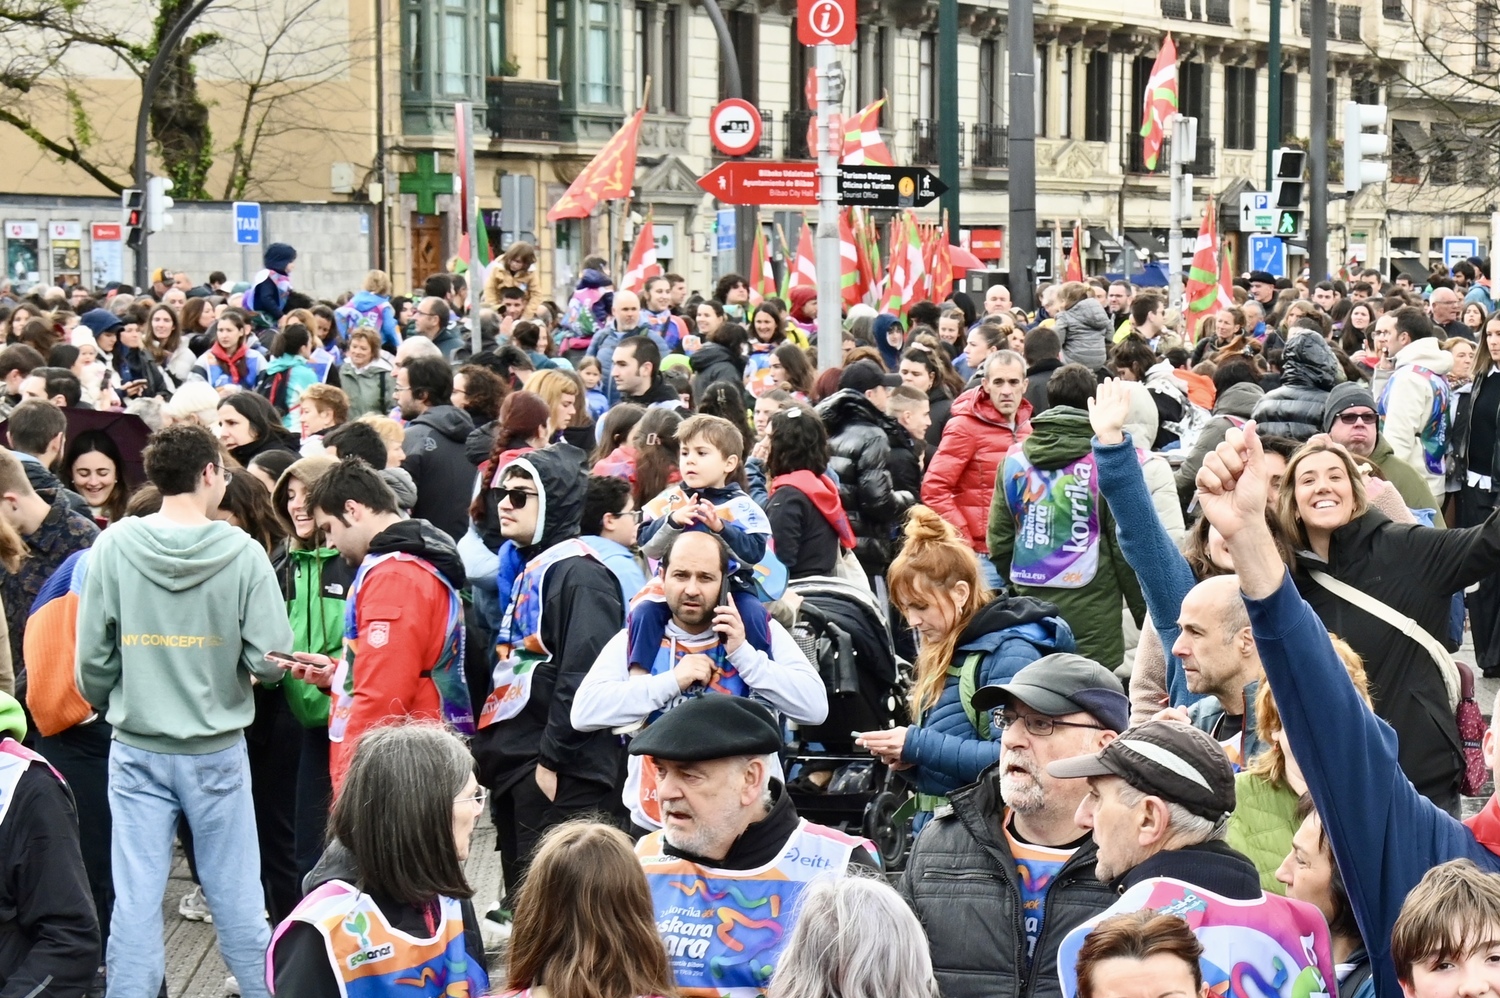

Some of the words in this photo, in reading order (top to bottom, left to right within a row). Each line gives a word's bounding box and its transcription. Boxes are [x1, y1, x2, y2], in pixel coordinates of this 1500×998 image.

[843, 172, 867, 180] Turismo
[843, 181, 863, 190] Oficina
[863, 182, 871, 190] de
[871, 182, 895, 190] Turismo
[769, 189, 788, 197] Bilbao
[789, 189, 800, 198] City
[843, 191, 862, 199] Tourist
[862, 191, 879, 199] Office
[237, 216, 259, 231] TAXI
[1062, 462, 1093, 553] korrika
[1025, 504, 1036, 549] Euskara
[1034, 505, 1049, 545] gara
[1062, 572, 1083, 583] aek
[141, 634, 205, 648] CONCEPT
[663, 935, 710, 959] ara
[351, 945, 392, 967] goiener
